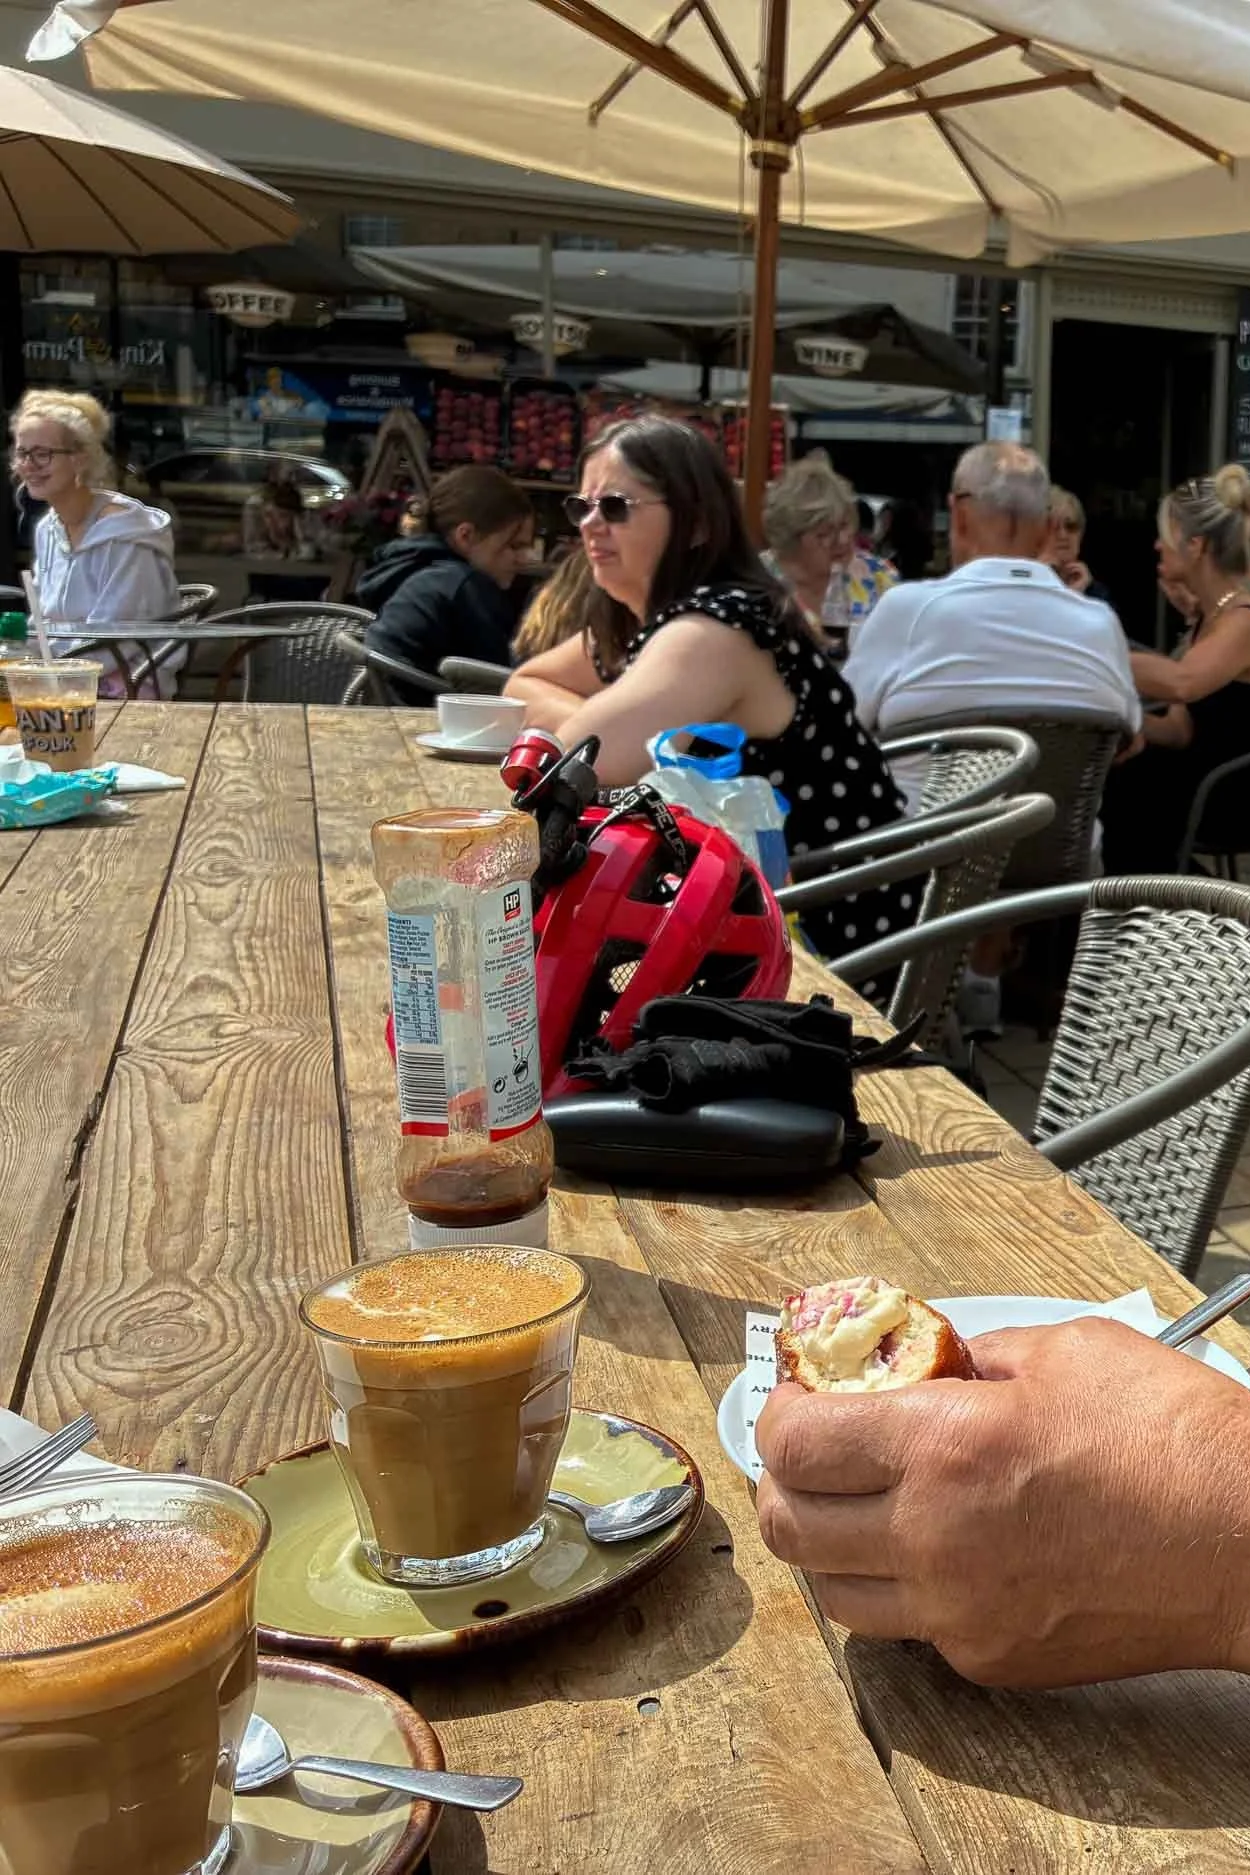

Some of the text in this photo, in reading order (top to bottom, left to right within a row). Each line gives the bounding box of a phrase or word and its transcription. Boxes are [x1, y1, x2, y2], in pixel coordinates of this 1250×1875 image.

[212, 290, 289, 314] OFFEE
[800, 346, 856, 368] WINE
[17, 707, 96, 732] ANTR
[22, 735, 77, 753] FOLK
[505, 893, 519, 911] HP
[750, 1325, 779, 1335] TRY
